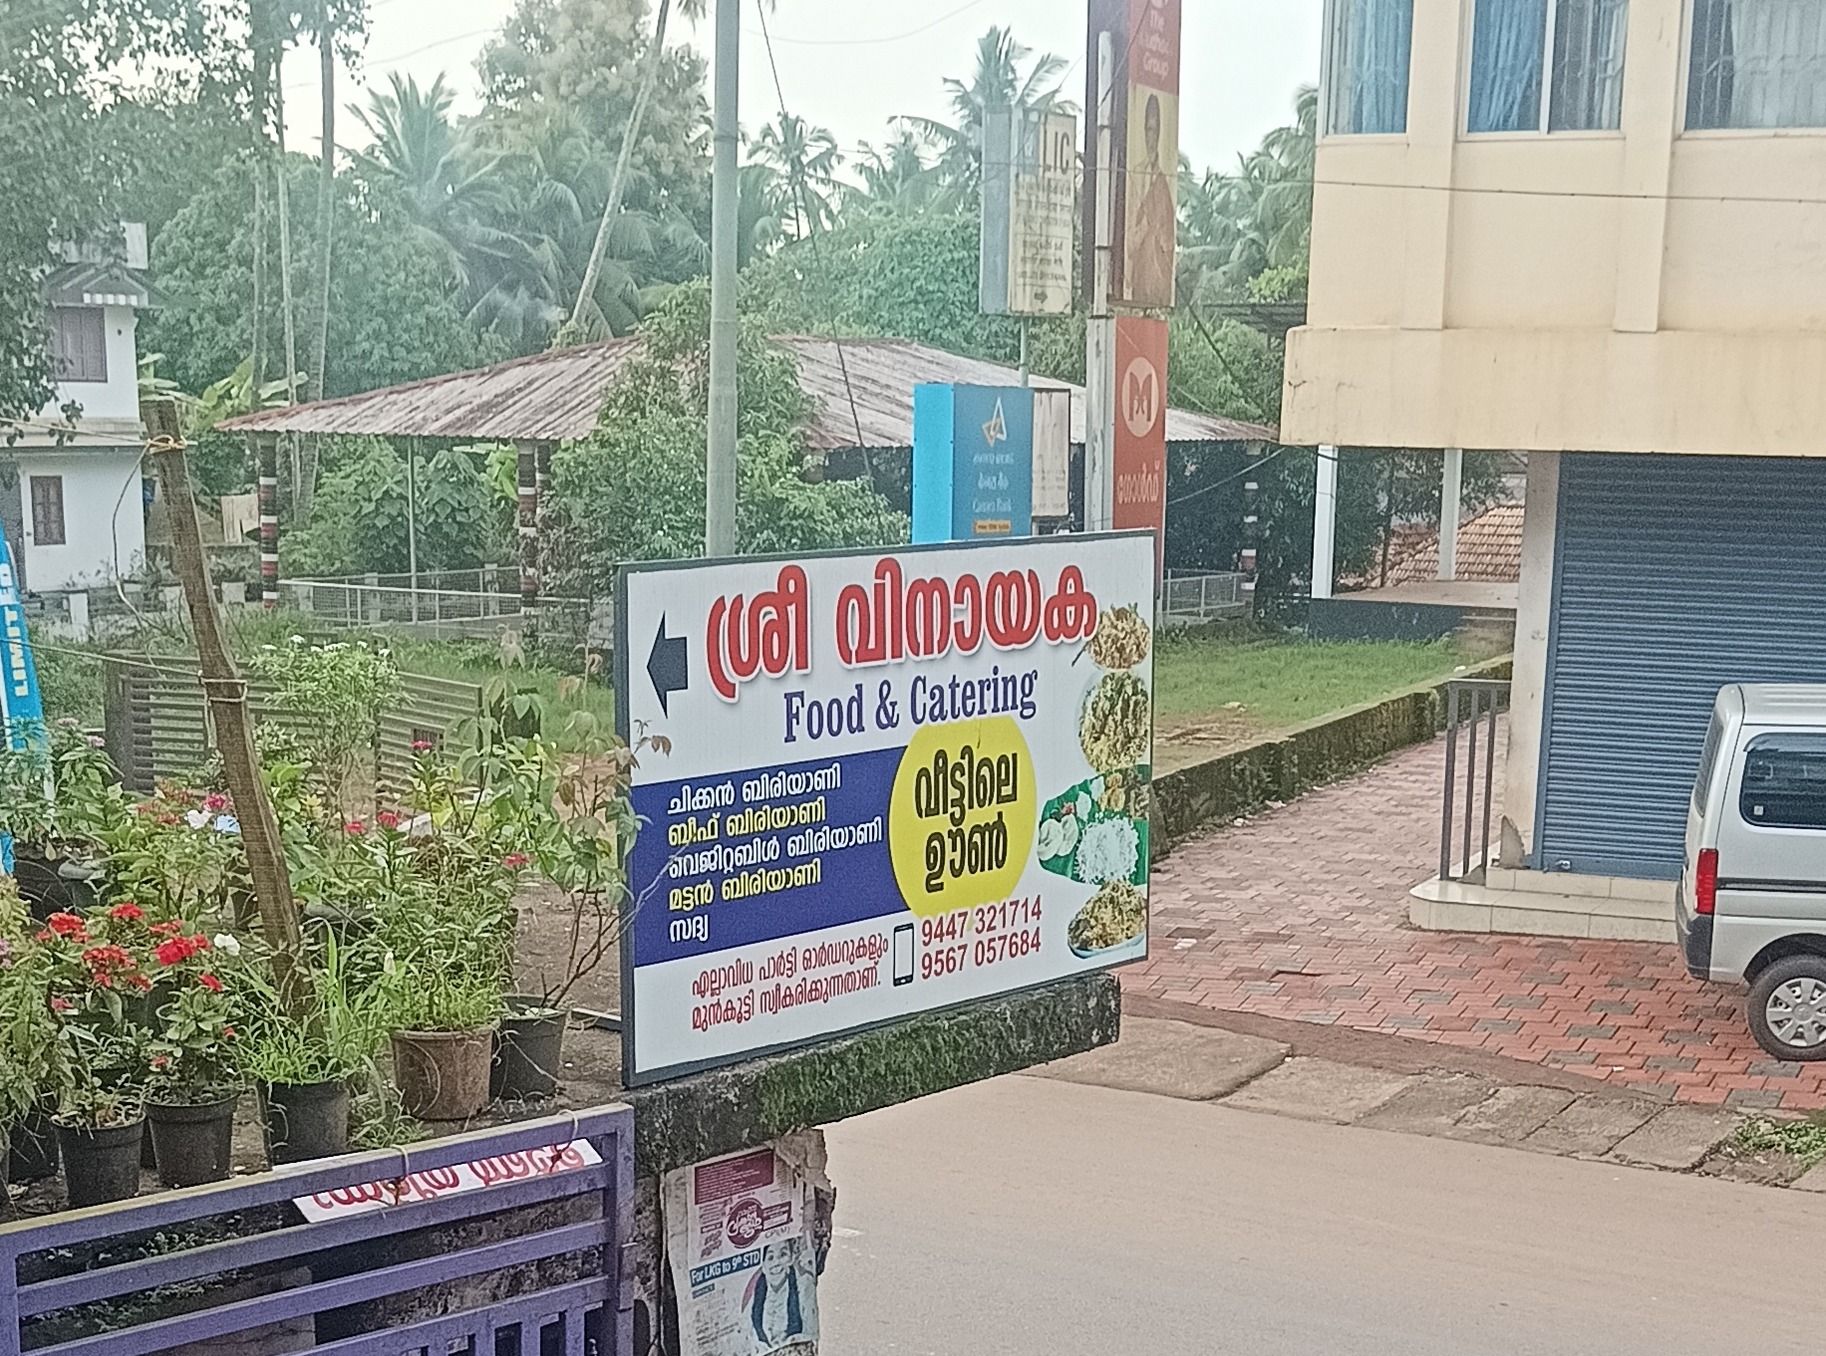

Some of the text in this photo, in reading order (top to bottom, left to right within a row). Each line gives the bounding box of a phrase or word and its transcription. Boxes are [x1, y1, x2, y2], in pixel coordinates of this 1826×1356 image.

[706, 557, 1098, 699] ശ്രീ വിനായക
[783, 665, 1038, 743] Food & Catering
[667, 762, 841, 815] ചിക്കൻ ബിരിയാണി
[914, 745, 1019, 828] വീട്ടിലെ
[726, 796, 826, 837] ബിരിയാണി
[787, 816, 883, 858] ബിരിയാണി
[669, 857, 822, 911] മട്ടൻ ബിരിയാണി
[921, 894, 1042, 947] 9447 321714
[691, 932, 889, 998] എല്ലാവിധ പാർട്ടി ഓർഡറുകളും
[920, 926, 1042, 980] 9567 057684
[691, 988, 755, 1033] മുൻകൂട്ടി
[690, 1268, 704, 1285] For
[703, 1263, 721, 1281] LKG
[722, 1260, 732, 1276] to
[742, 1250, 761, 1268] STD
